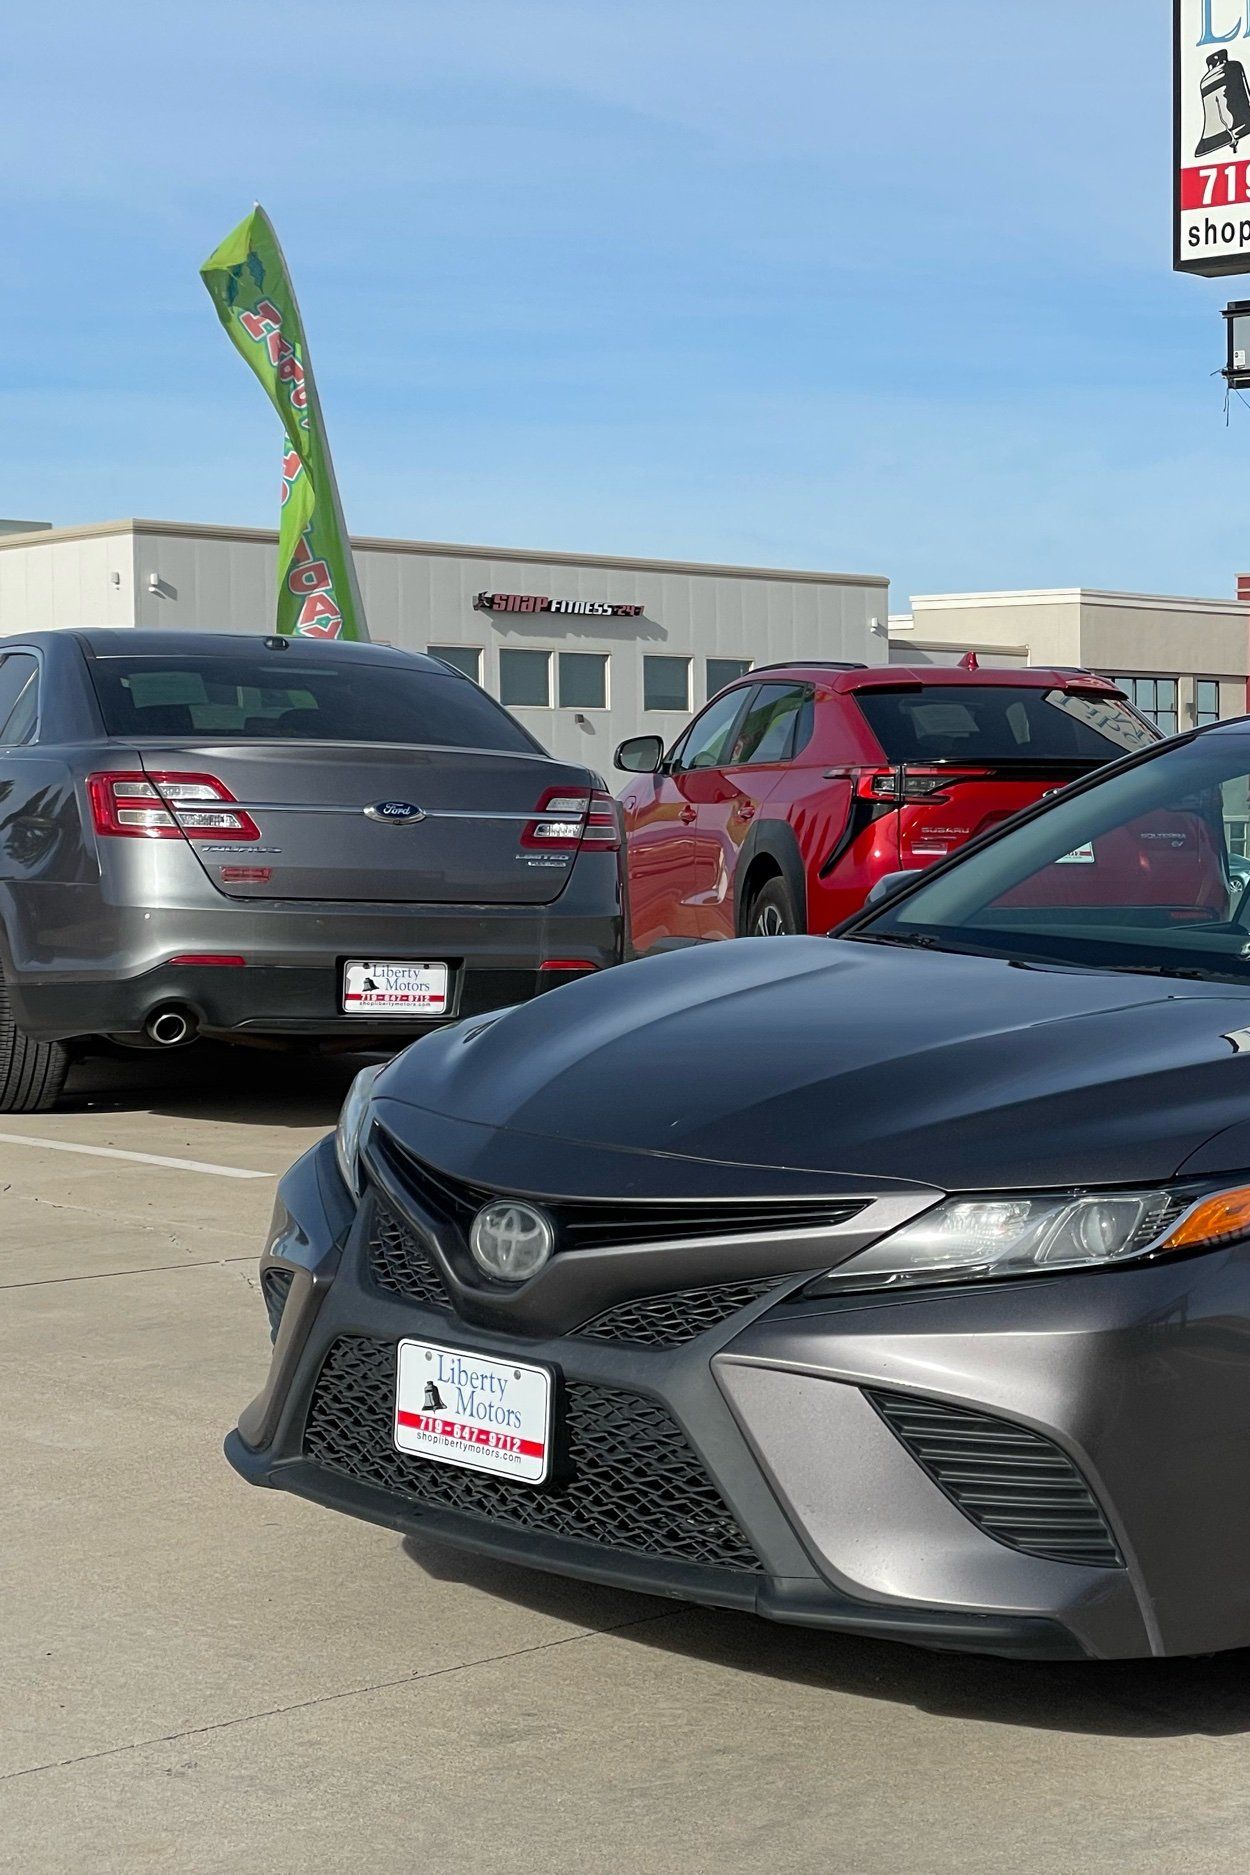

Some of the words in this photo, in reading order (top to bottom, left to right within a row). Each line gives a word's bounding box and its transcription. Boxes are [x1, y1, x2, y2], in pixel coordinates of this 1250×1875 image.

[550, 600, 613, 616] FITNESS
[383, 803, 410, 815] Ford
[372, 965, 420, 980] Liberty
[385, 978, 430, 991] Motors
[437, 1354, 508, 1401] Liberty
[455, 1386, 522, 1429] Motors
[416, 1430, 522, 1464] shoplibertymotors.com
[419, 1416, 522, 1453] 719-647-9712
